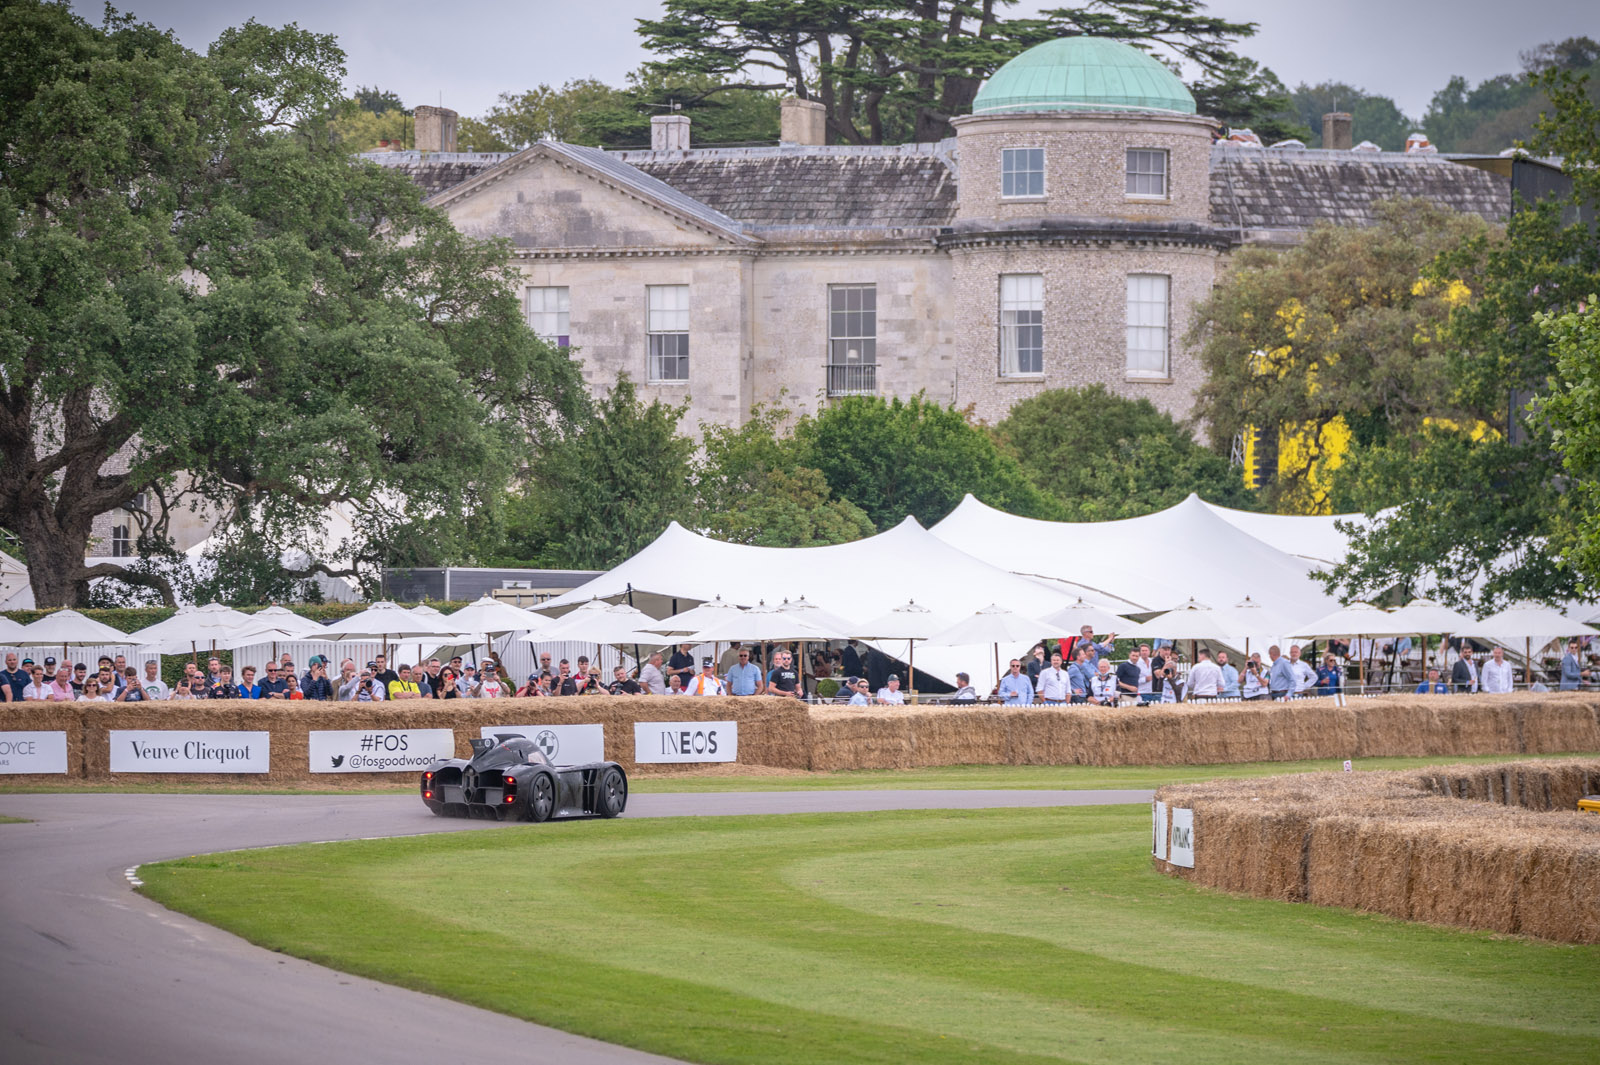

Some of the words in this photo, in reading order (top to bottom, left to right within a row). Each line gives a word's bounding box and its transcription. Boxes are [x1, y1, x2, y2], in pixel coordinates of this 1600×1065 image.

[130, 740, 180, 760] Veuve
[183, 740, 250, 764] Clicquot
[361, 734, 408, 751] #FOS
[660, 731, 718, 754] INEOS
[349, 754, 437, 769] @fosgoodwood
